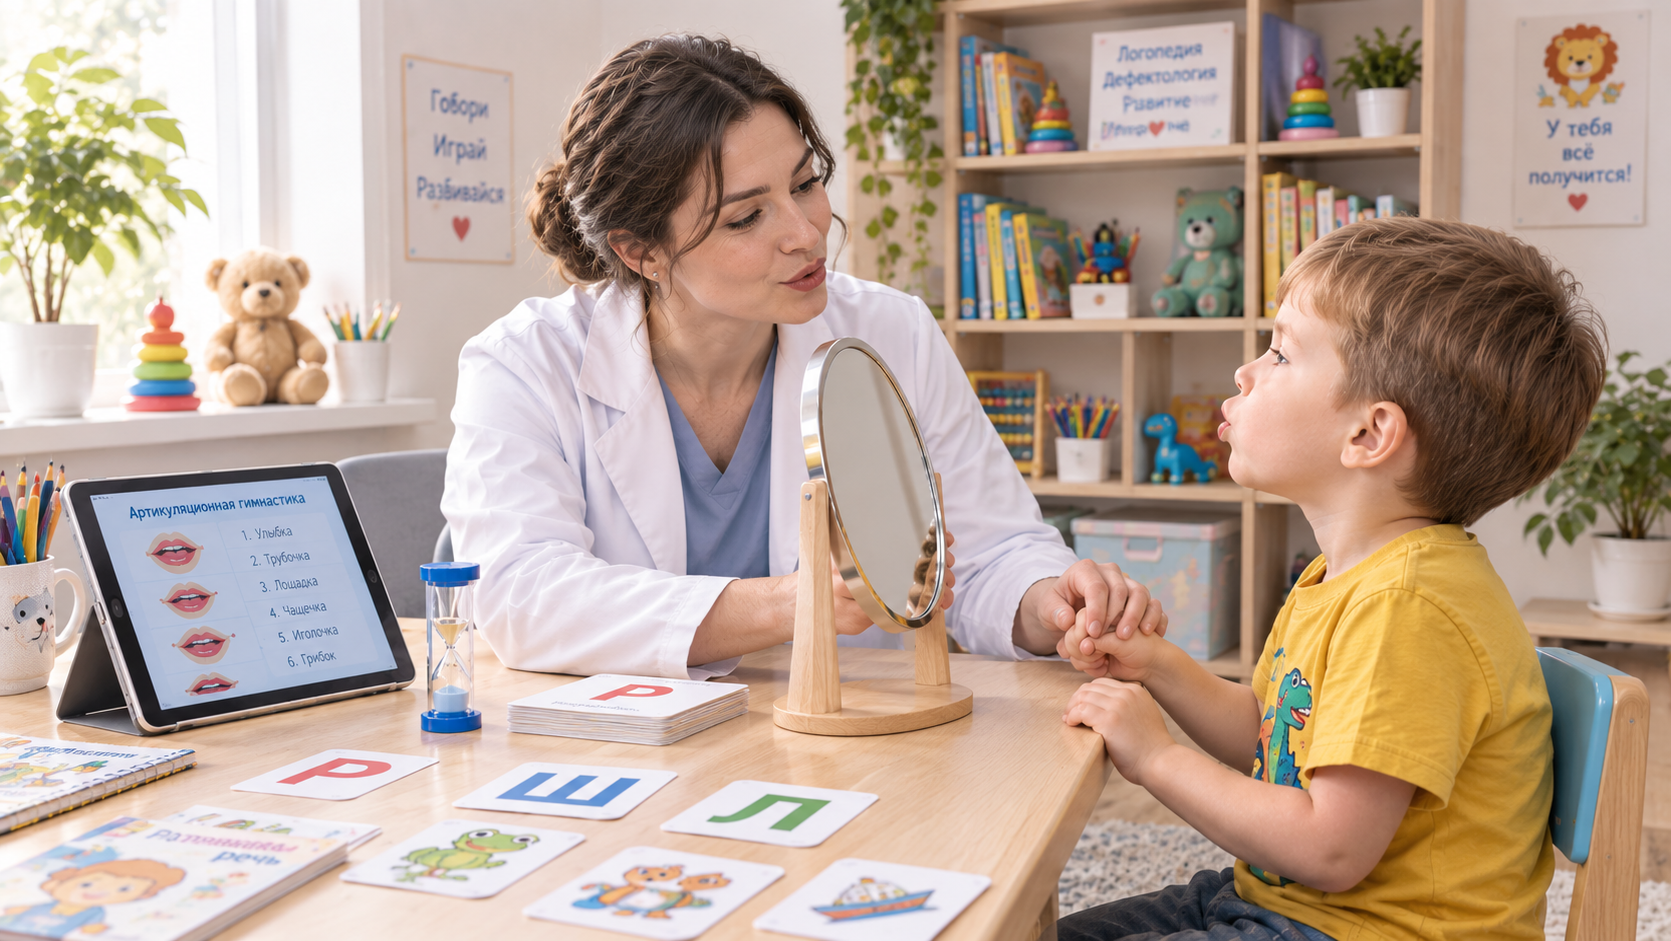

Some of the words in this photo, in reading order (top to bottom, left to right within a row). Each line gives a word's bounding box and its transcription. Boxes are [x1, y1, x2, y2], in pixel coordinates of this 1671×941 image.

[1117, 43, 1203, 62] Логопедия
[1103, 67, 1217, 90] Дефектология
[1546, 119, 1560, 139] У
[1567, 117, 1612, 137] тебя
[434, 133, 487, 165] Играй
[1562, 142, 1594, 161] всё
[1529, 163, 1631, 189] получится!
[129, 501, 236, 521] Артикуляционная
[239, 494, 306, 509] гимнастика
[241, 530, 252, 541] 1.
[250, 555, 261, 567] 2.
[263, 551, 310, 567] Трубочка
[260, 581, 271, 593] 3.
[270, 608, 280, 618] 4.
[278, 631, 289, 643] 5.
[292, 626, 339, 640] Иголочка
[287, 656, 298, 667] 6.
[301, 651, 337, 667] Грибок
[589, 684, 673, 701] Р
[276, 758, 392, 785] Р
[495, 772, 641, 808] Ш
[706, 794, 832, 831] Л
[209, 851, 281, 866] речь
